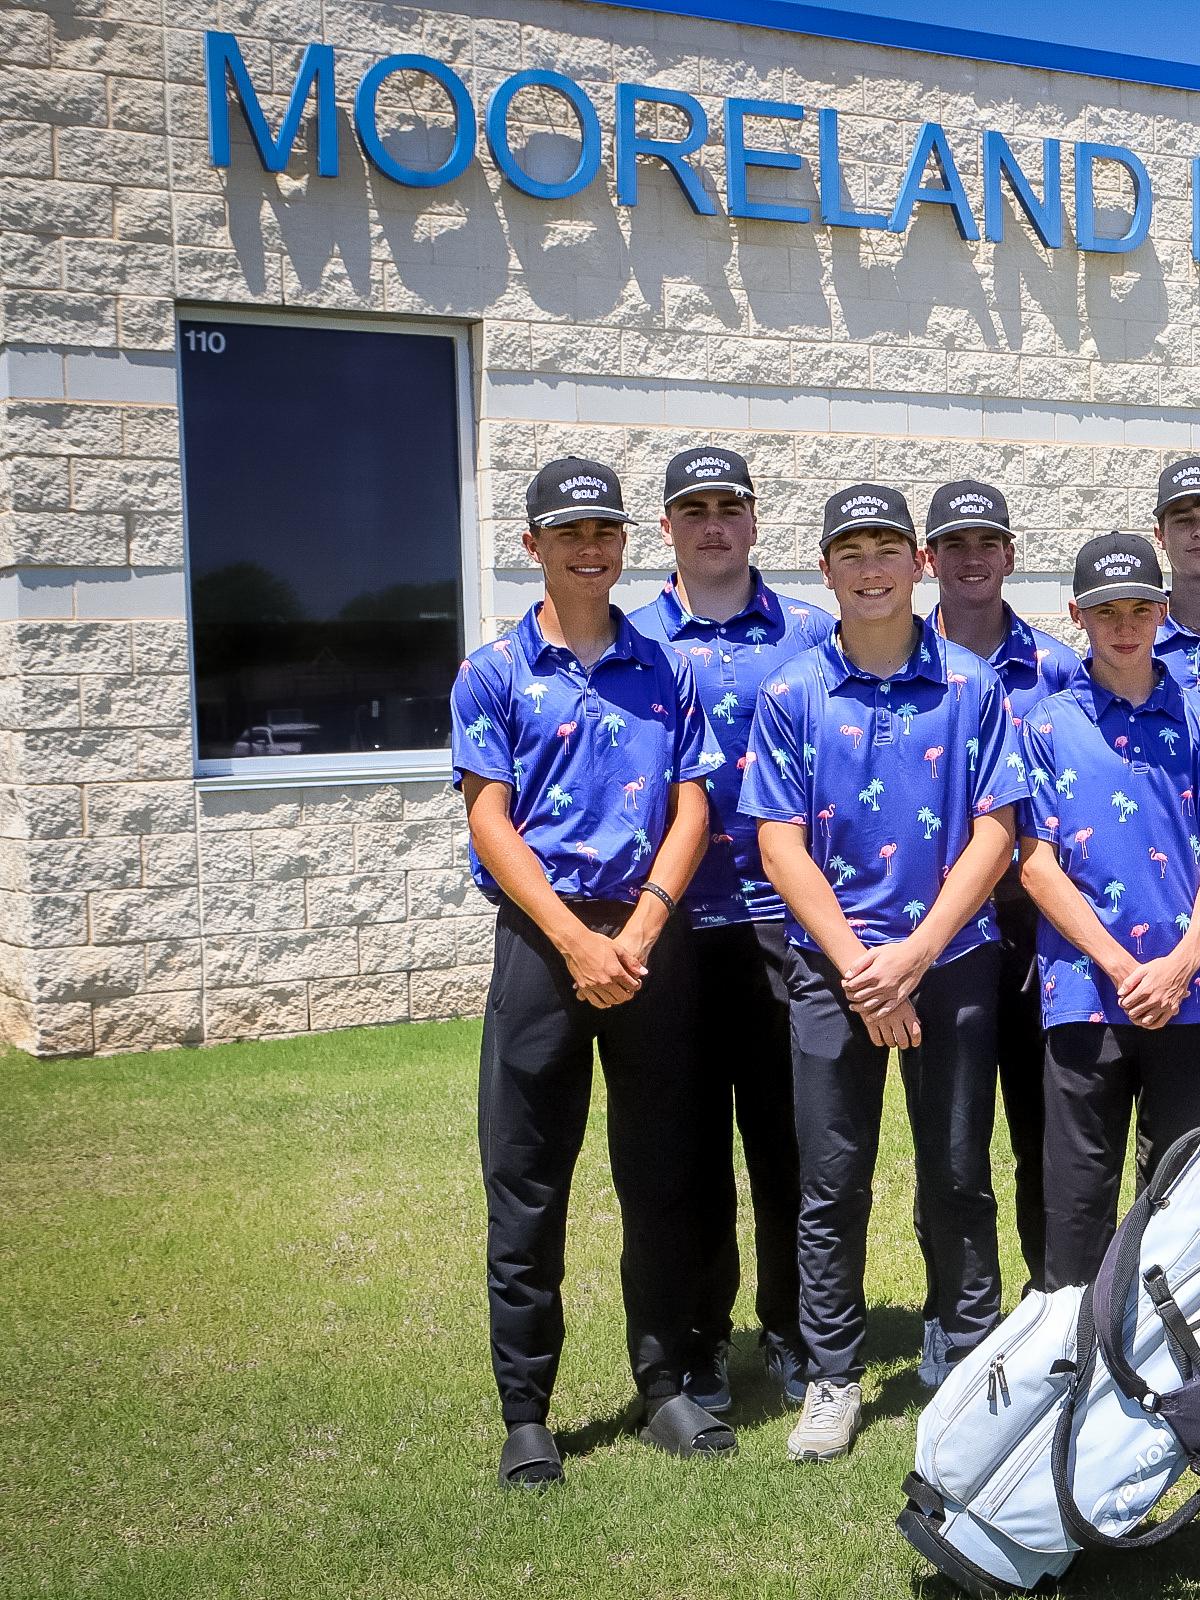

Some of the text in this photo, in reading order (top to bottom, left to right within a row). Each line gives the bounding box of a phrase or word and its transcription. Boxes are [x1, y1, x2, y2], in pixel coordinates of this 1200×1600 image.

[204, 31, 1152, 254] MOORELAND
[184, 330, 226, 353] 110
[685, 457, 731, 473] BEARCATS
[697, 468, 721, 477] GOLF
[558, 476, 607, 492] BEARCATS
[572, 488, 599, 500] GOLF
[949, 493, 993, 510] BEARCATS
[841, 496, 889, 514] BEARCATS
[851, 507, 877, 516] GOLF
[960, 505, 985, 514] GOLF
[1094, 554, 1141, 571] BEARCATS
[1105, 566, 1131, 576] GOLF
